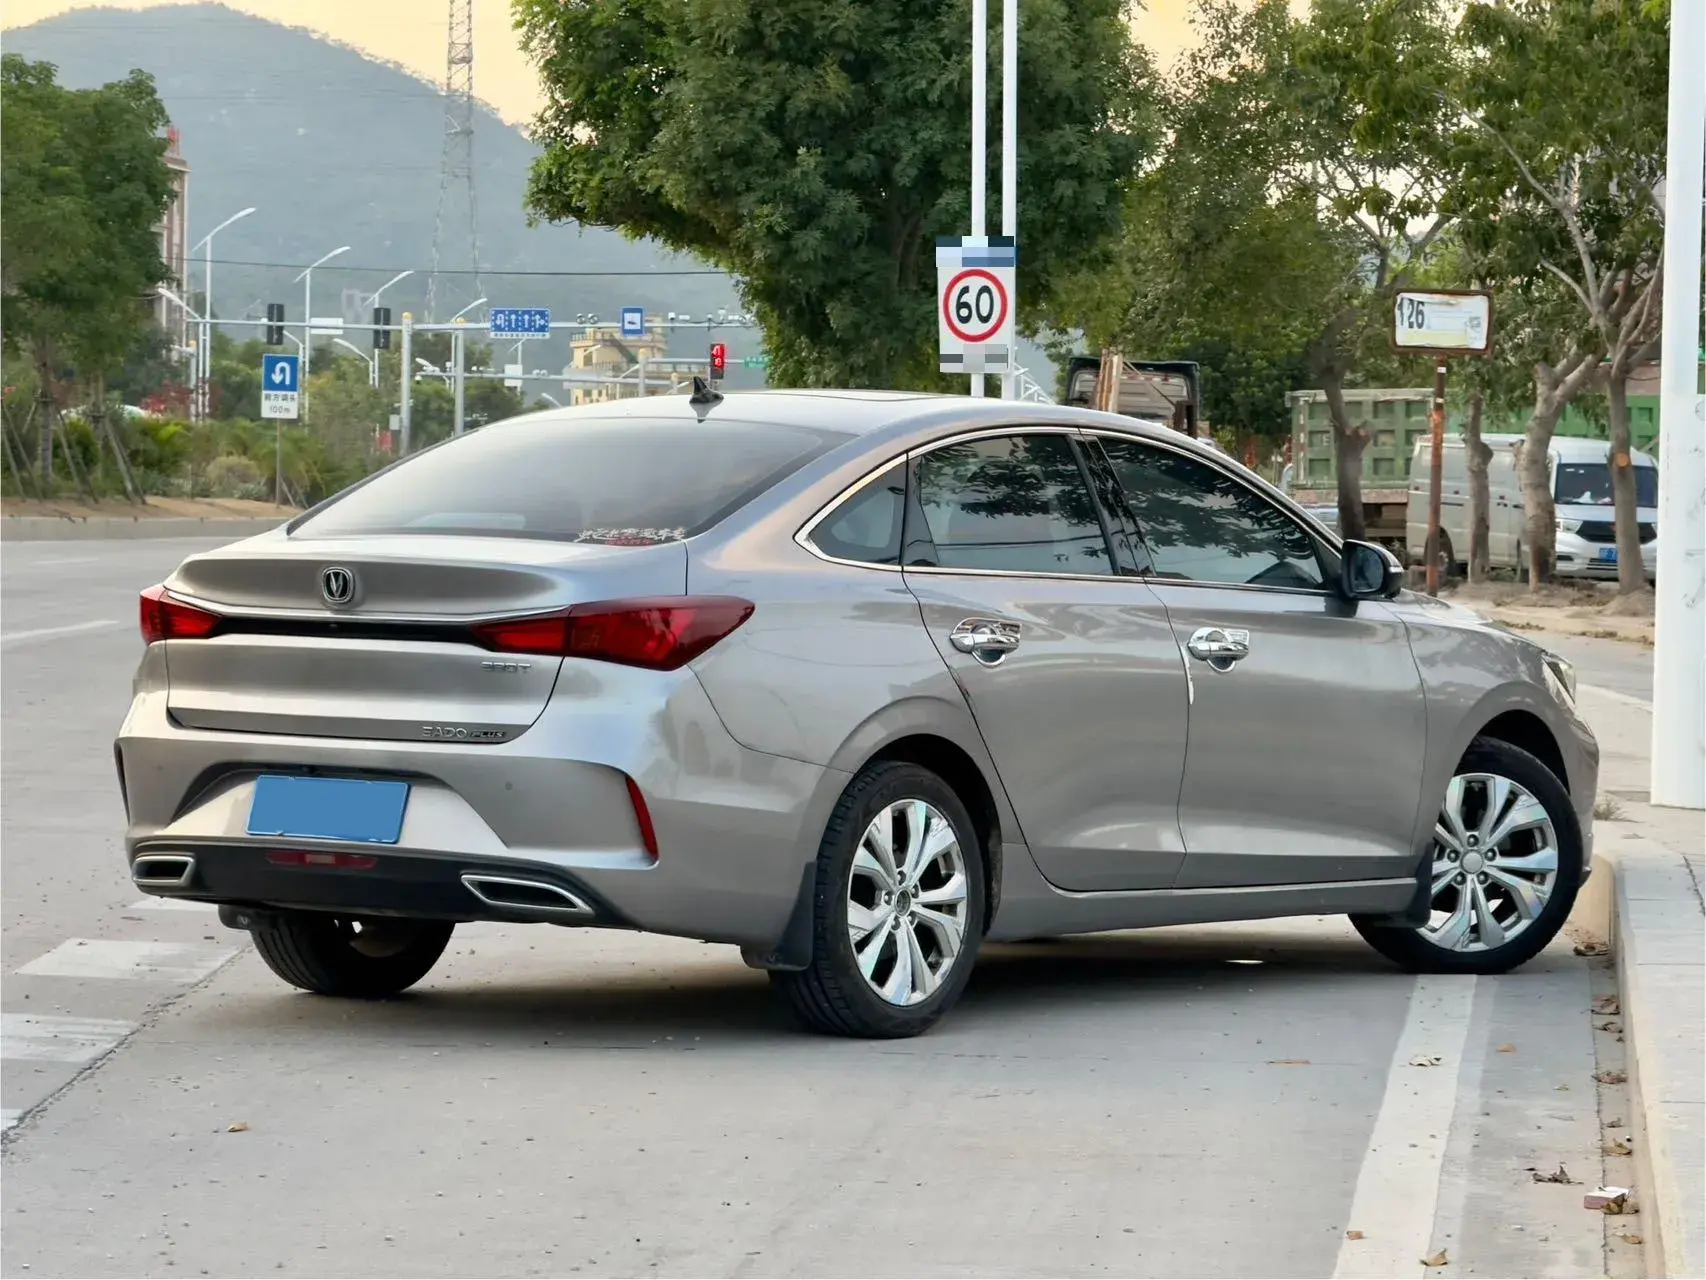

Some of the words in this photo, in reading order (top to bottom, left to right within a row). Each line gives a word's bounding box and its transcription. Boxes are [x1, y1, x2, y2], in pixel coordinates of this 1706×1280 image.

[956, 285, 994, 324] 60
[1397, 297, 1425, 329] 126
[422, 726, 467, 738] EADO
